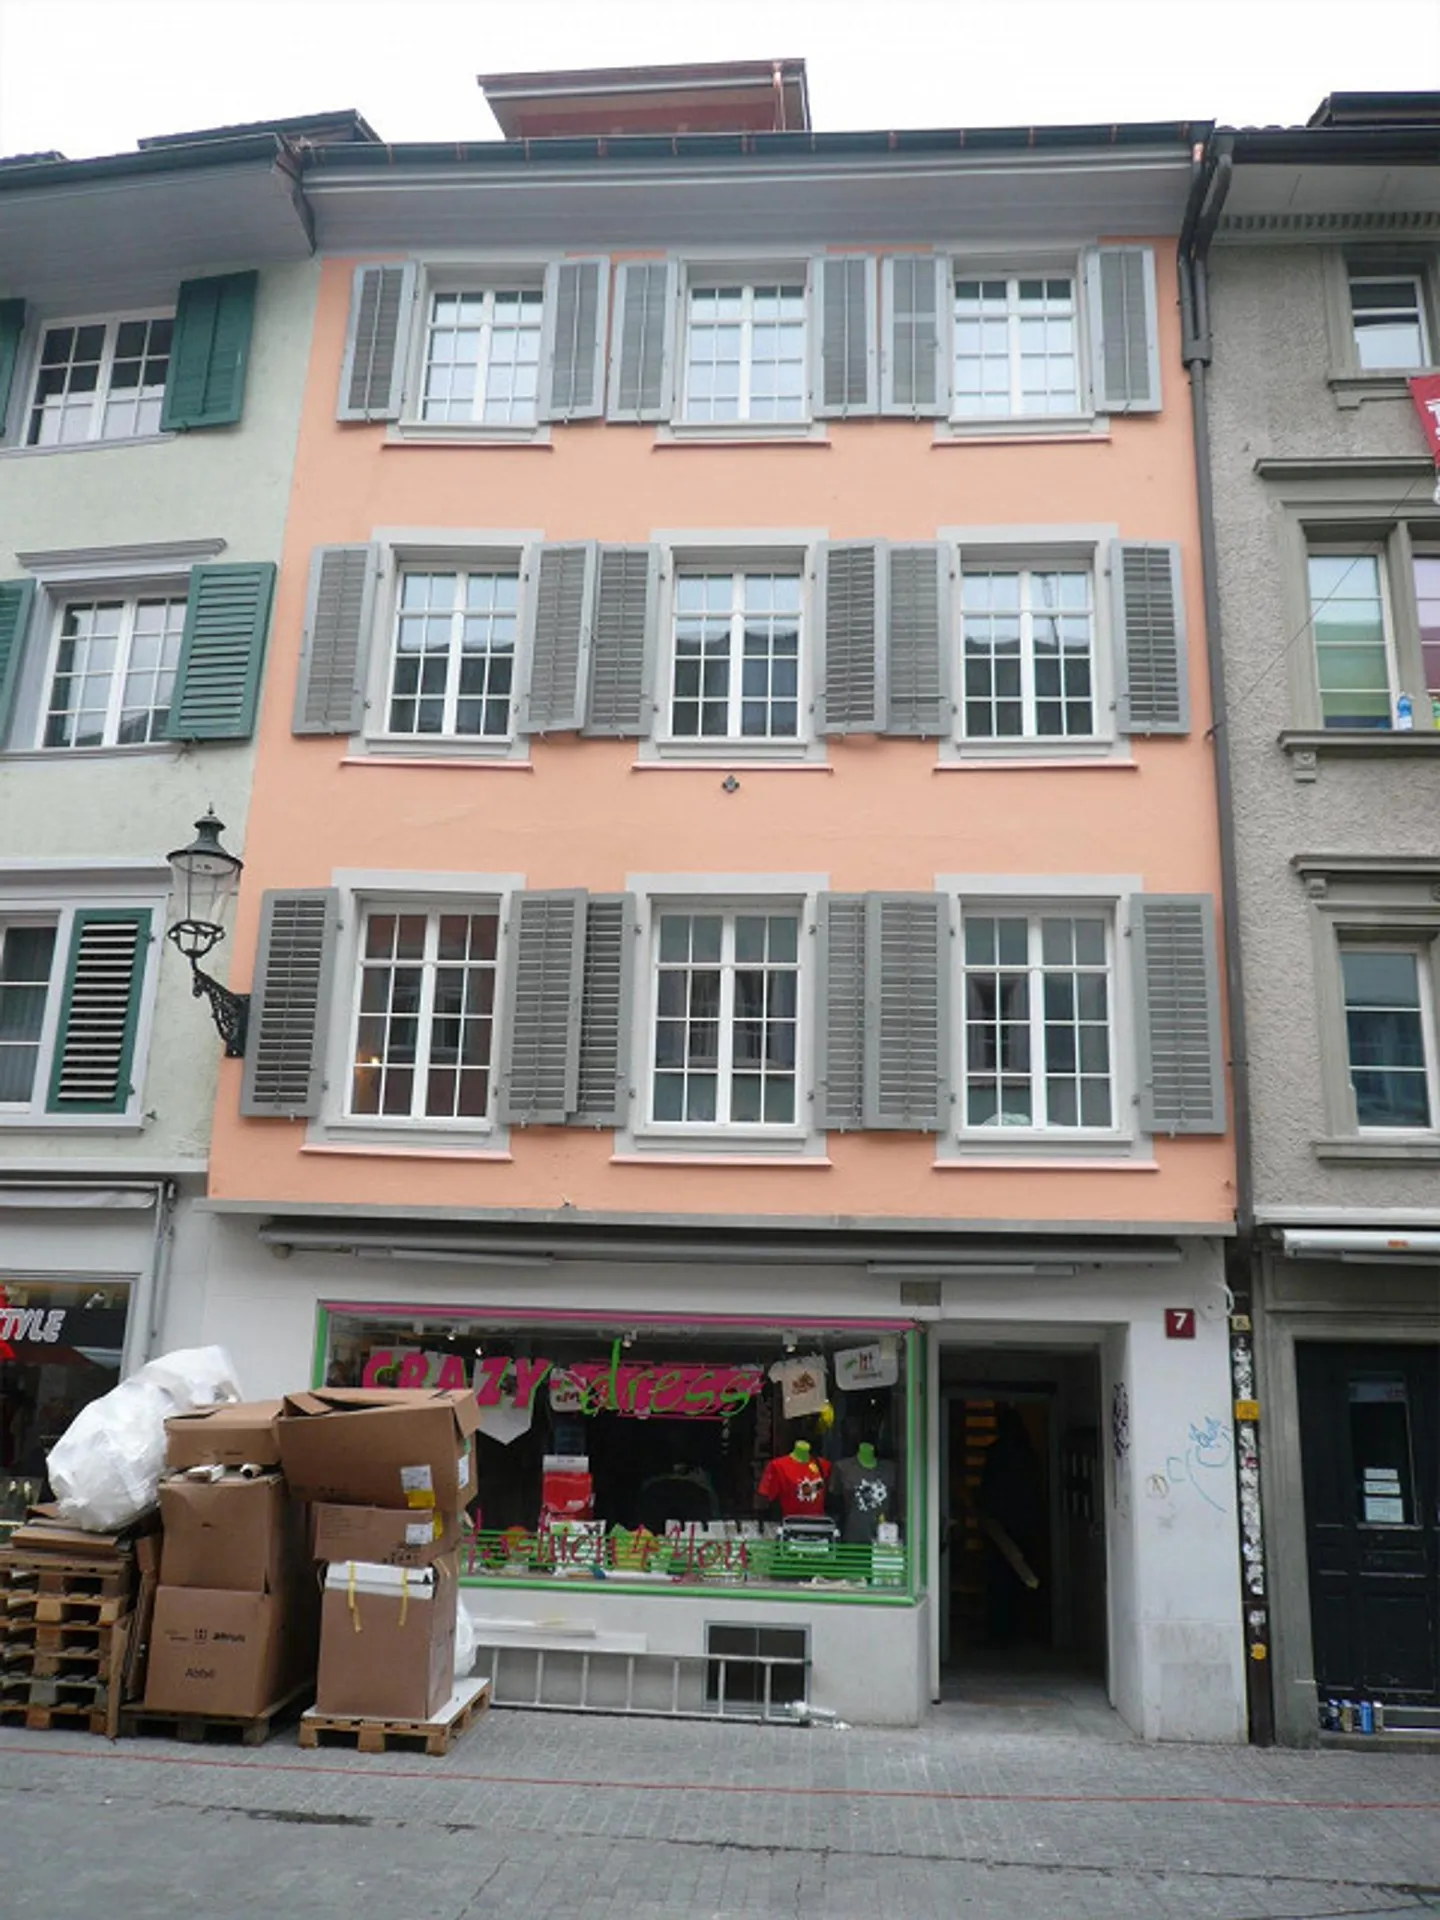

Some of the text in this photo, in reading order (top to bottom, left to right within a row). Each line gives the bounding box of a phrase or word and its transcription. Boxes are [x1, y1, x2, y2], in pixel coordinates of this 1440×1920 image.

[0, 1308, 66, 1343] TYLE
[1173, 1311, 1187, 1330] 7
[362, 1337, 752, 1417] CRAZY dress
[631, 1523, 658, 1572] 4
[668, 1522, 748, 1584] You
